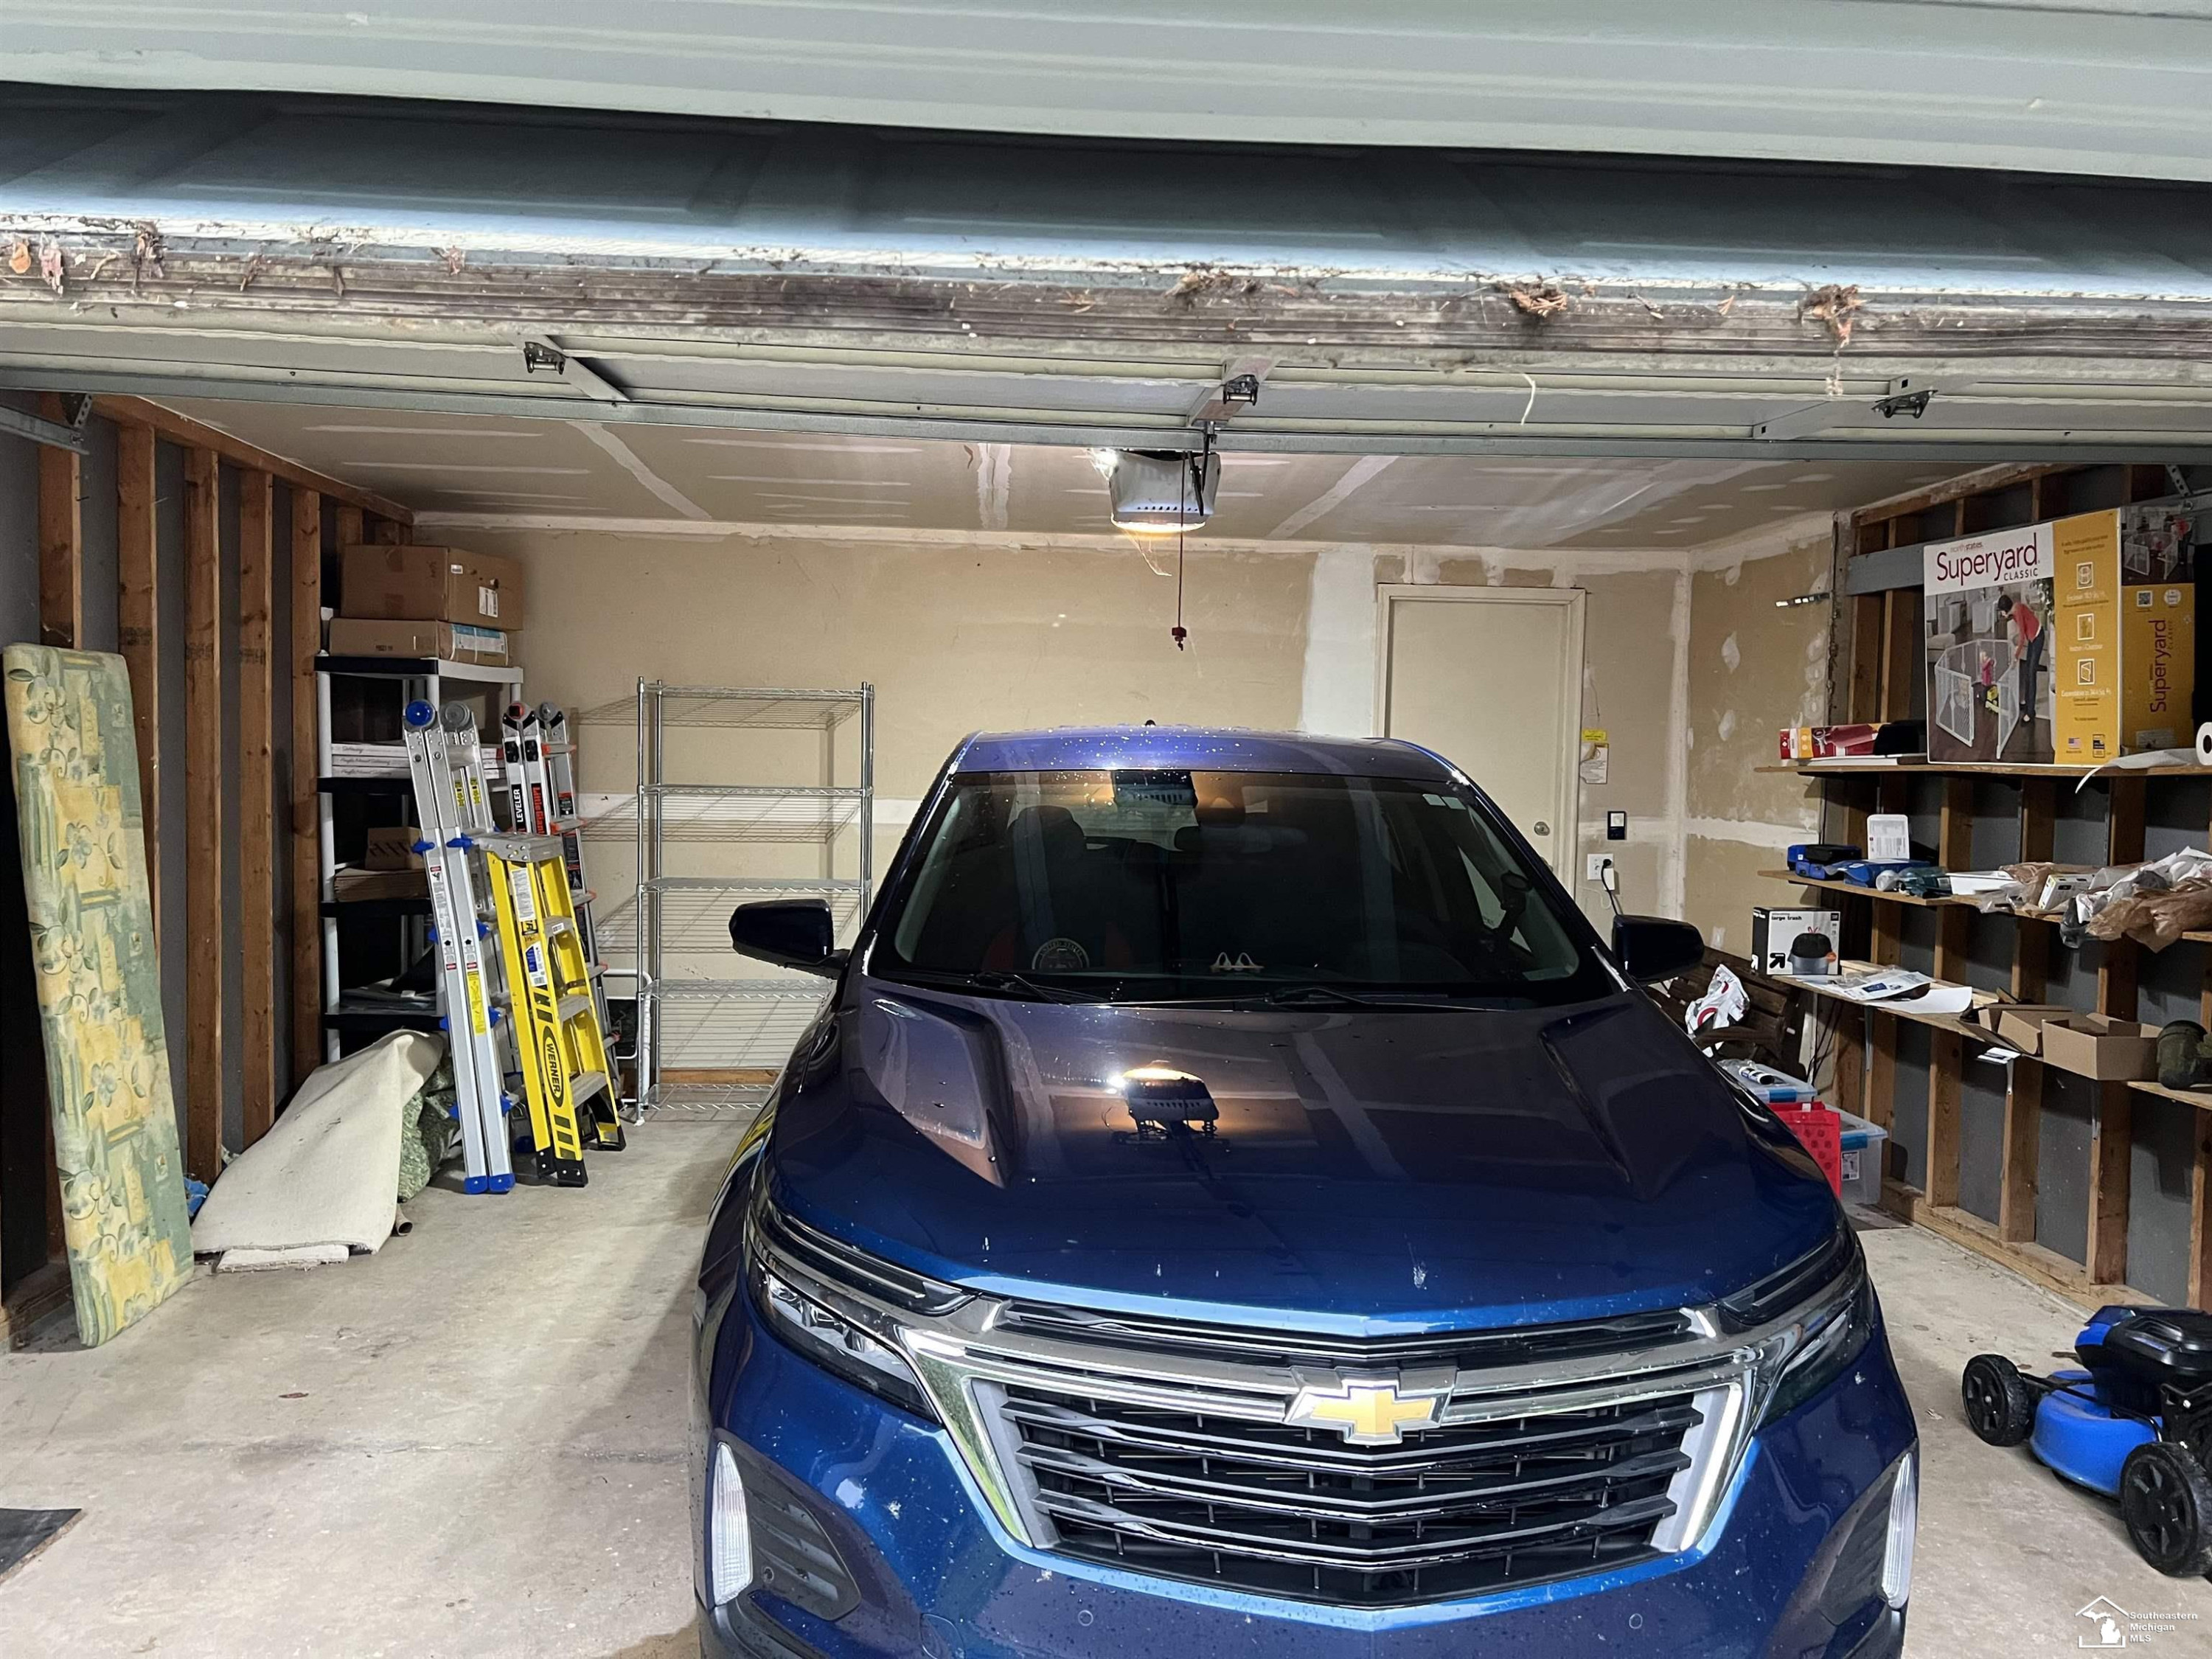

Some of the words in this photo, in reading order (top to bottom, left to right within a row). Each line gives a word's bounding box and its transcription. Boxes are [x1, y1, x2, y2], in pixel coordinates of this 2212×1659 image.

[1937, 532, 2037, 586] Superyard
[2003, 568, 2039, 581] CLASSIC
[2149, 619, 2171, 713] Superyard
[513, 788, 524, 823] LEVELER
[532, 787, 542, 810] Little
[546, 1043, 561, 1093] WERNER
